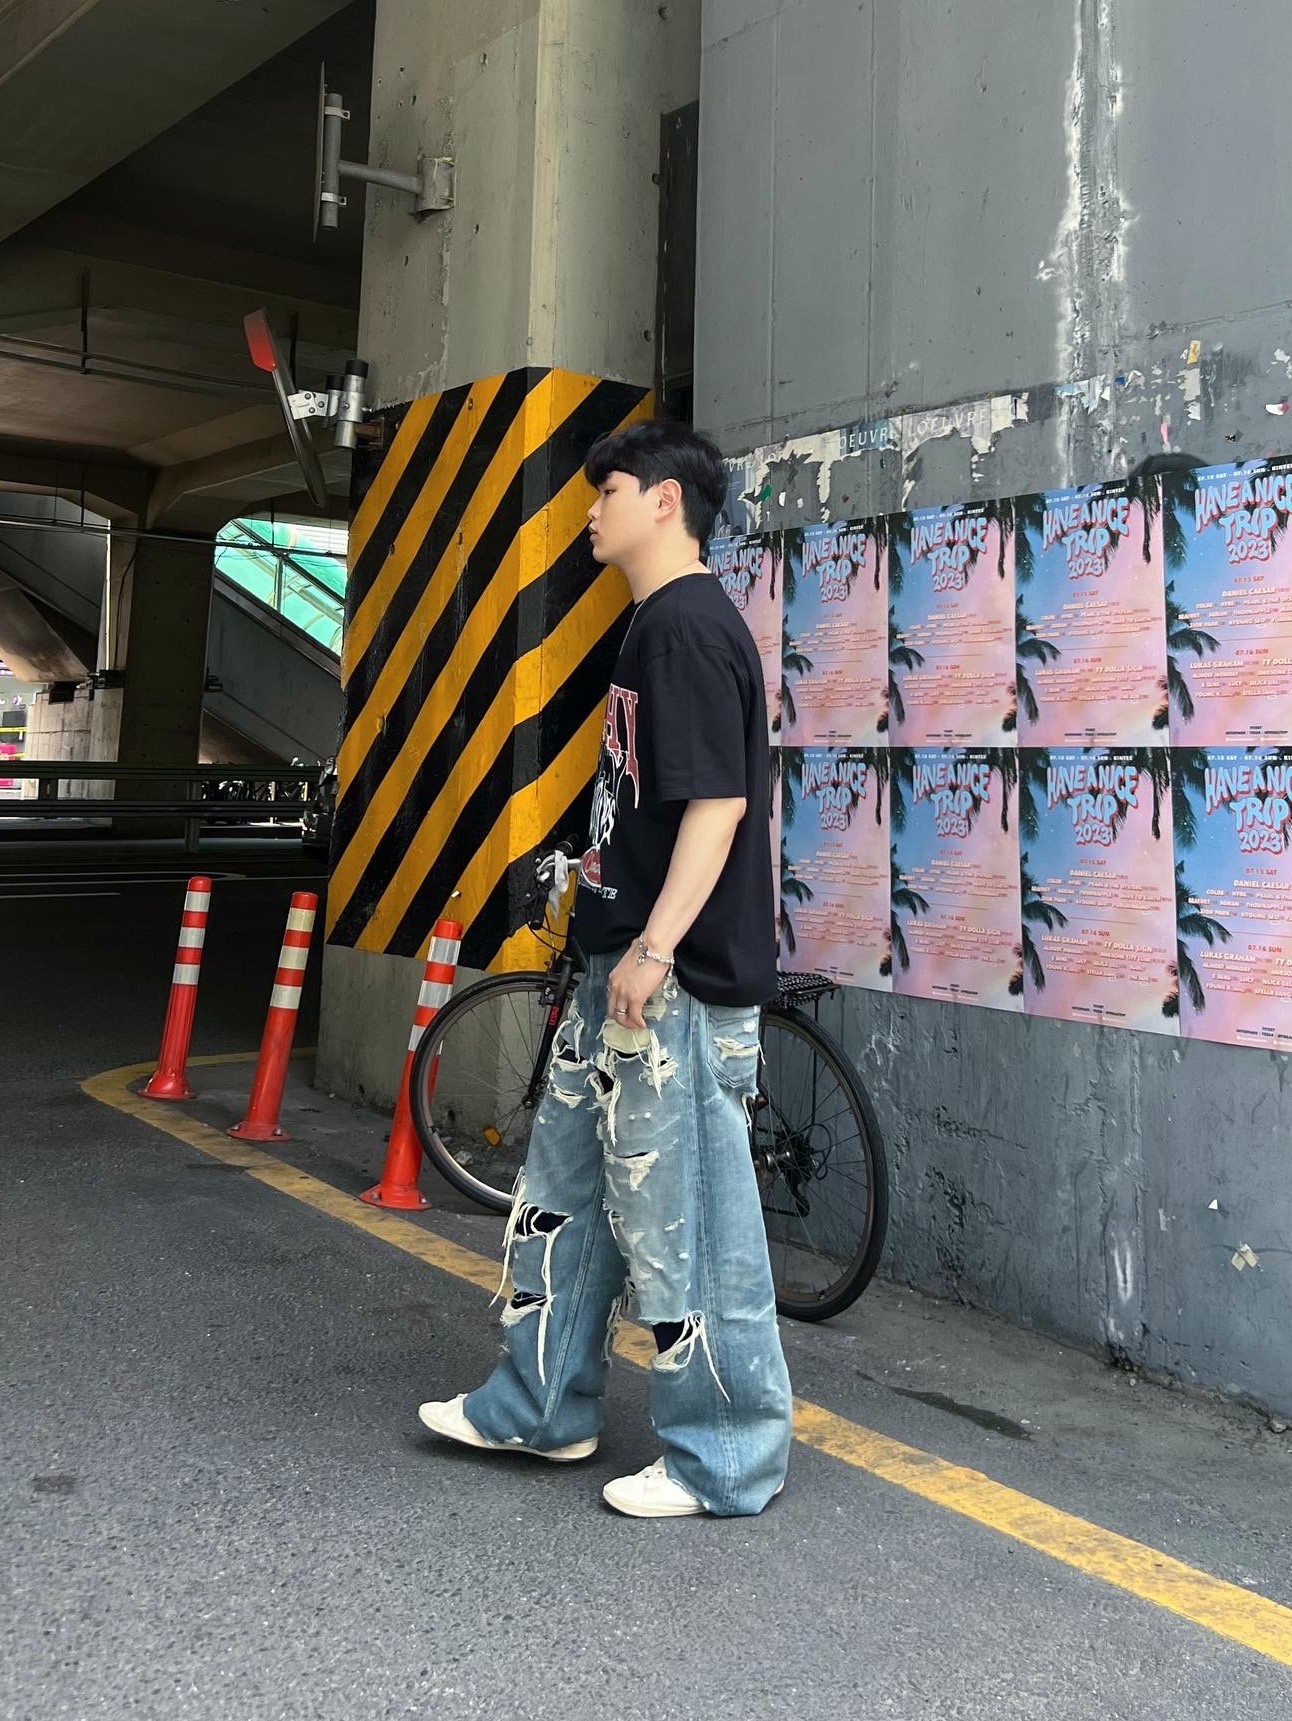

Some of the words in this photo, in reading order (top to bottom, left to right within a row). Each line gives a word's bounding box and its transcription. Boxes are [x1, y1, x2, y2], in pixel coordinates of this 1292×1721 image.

[1218, 505, 1278, 545] TRIP
[1061, 525, 1111, 562] TRIP
[1227, 537, 1269, 564] 2023
[927, 543, 970, 576] TRIP
[1068, 555, 1103, 580] 2023
[718, 571, 750, 596] TRIP
[816, 557, 852, 588] TRIP
[933, 570, 963, 593] 2023
[821, 583, 846, 603] 2023
[1221, 588, 1247, 598] DANIEL
[1248, 586, 1276, 596] CAESAR
[1189, 661, 1211, 670] LUKAS
[1212, 659, 1243, 669] GRAHAM
[1261, 657, 1271, 666] TY
[815, 785, 852, 814] TRIP
[930, 789, 974, 820] TRIP
[1067, 793, 1119, 827] TRIP
[820, 811, 846, 831] 2023
[1229, 796, 1291, 833] TRIP
[936, 816, 967, 838] 2023
[1075, 823, 1111, 846] 2023
[1238, 829, 1282, 854] 2023
[1233, 879, 1259, 888] DANIEL
[1260, 881, 1289, 890] CAESAR
[1104, 940, 1112, 949] TY
[1247, 944, 1266, 952] 07.16
[1267, 945, 1281, 953] SUN
[1200, 950, 1223, 960] LUKAS
[1224, 952, 1256, 963] GRAHAM
[1274, 957, 1284, 966] TY
